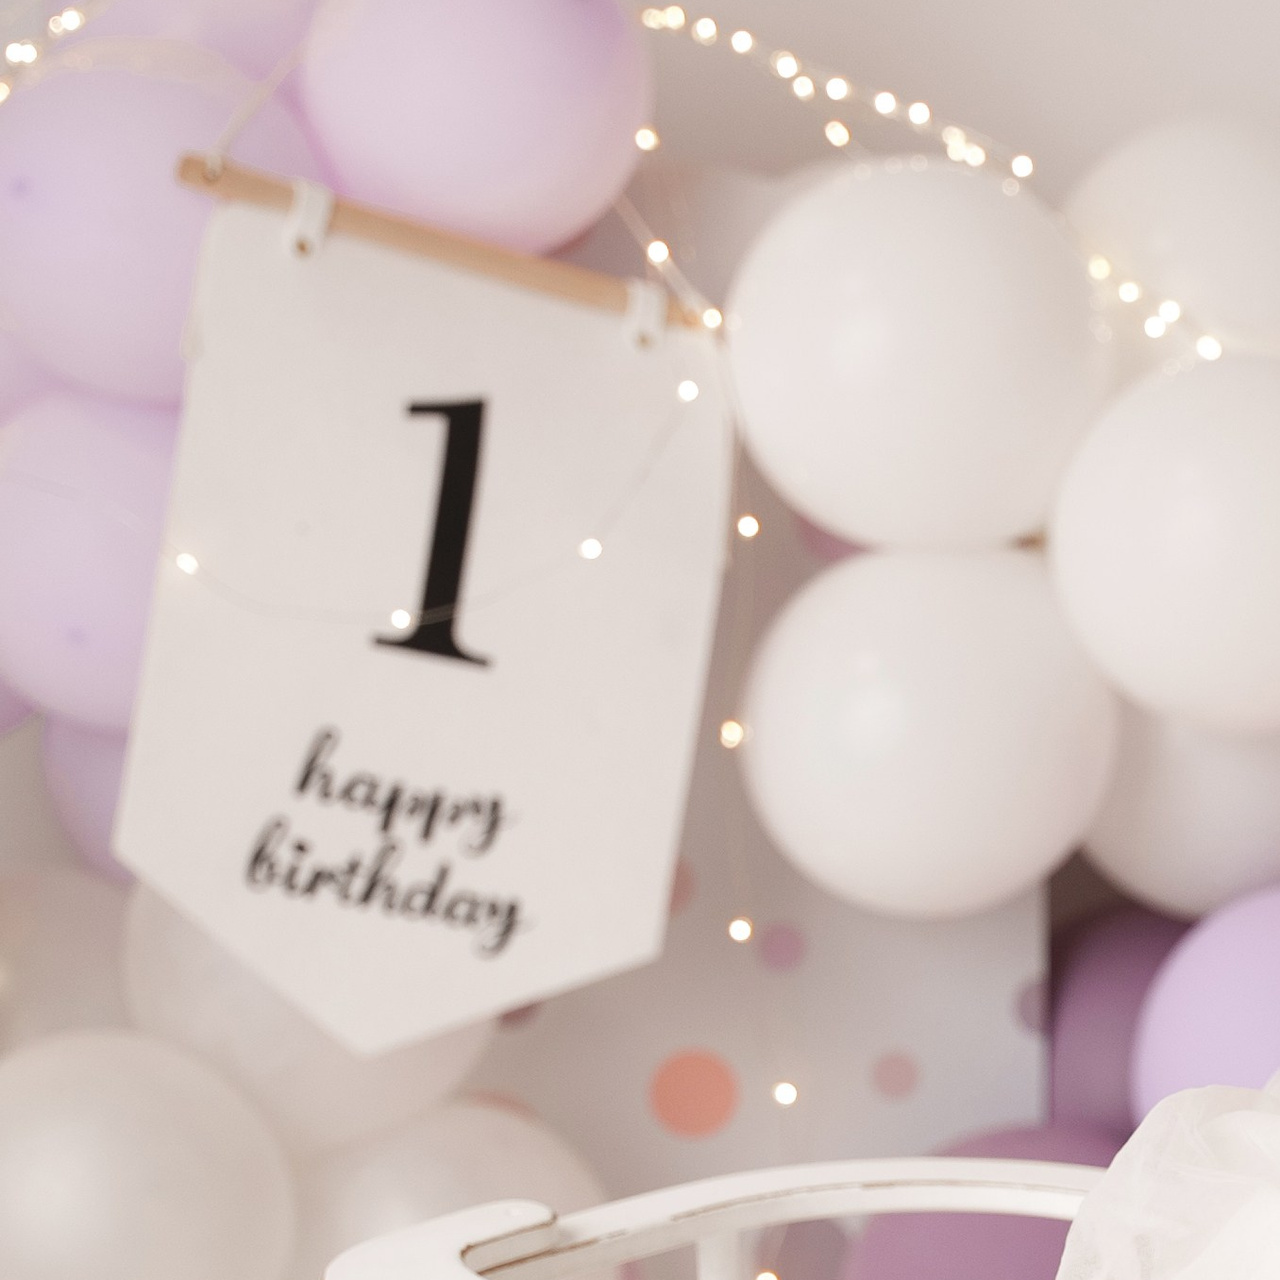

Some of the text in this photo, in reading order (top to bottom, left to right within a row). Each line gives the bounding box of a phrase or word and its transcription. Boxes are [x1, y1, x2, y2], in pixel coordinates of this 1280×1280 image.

[372, 396, 492, 669] 1
[294, 726, 506, 856] happy
[245, 817, 524, 957] birthday
